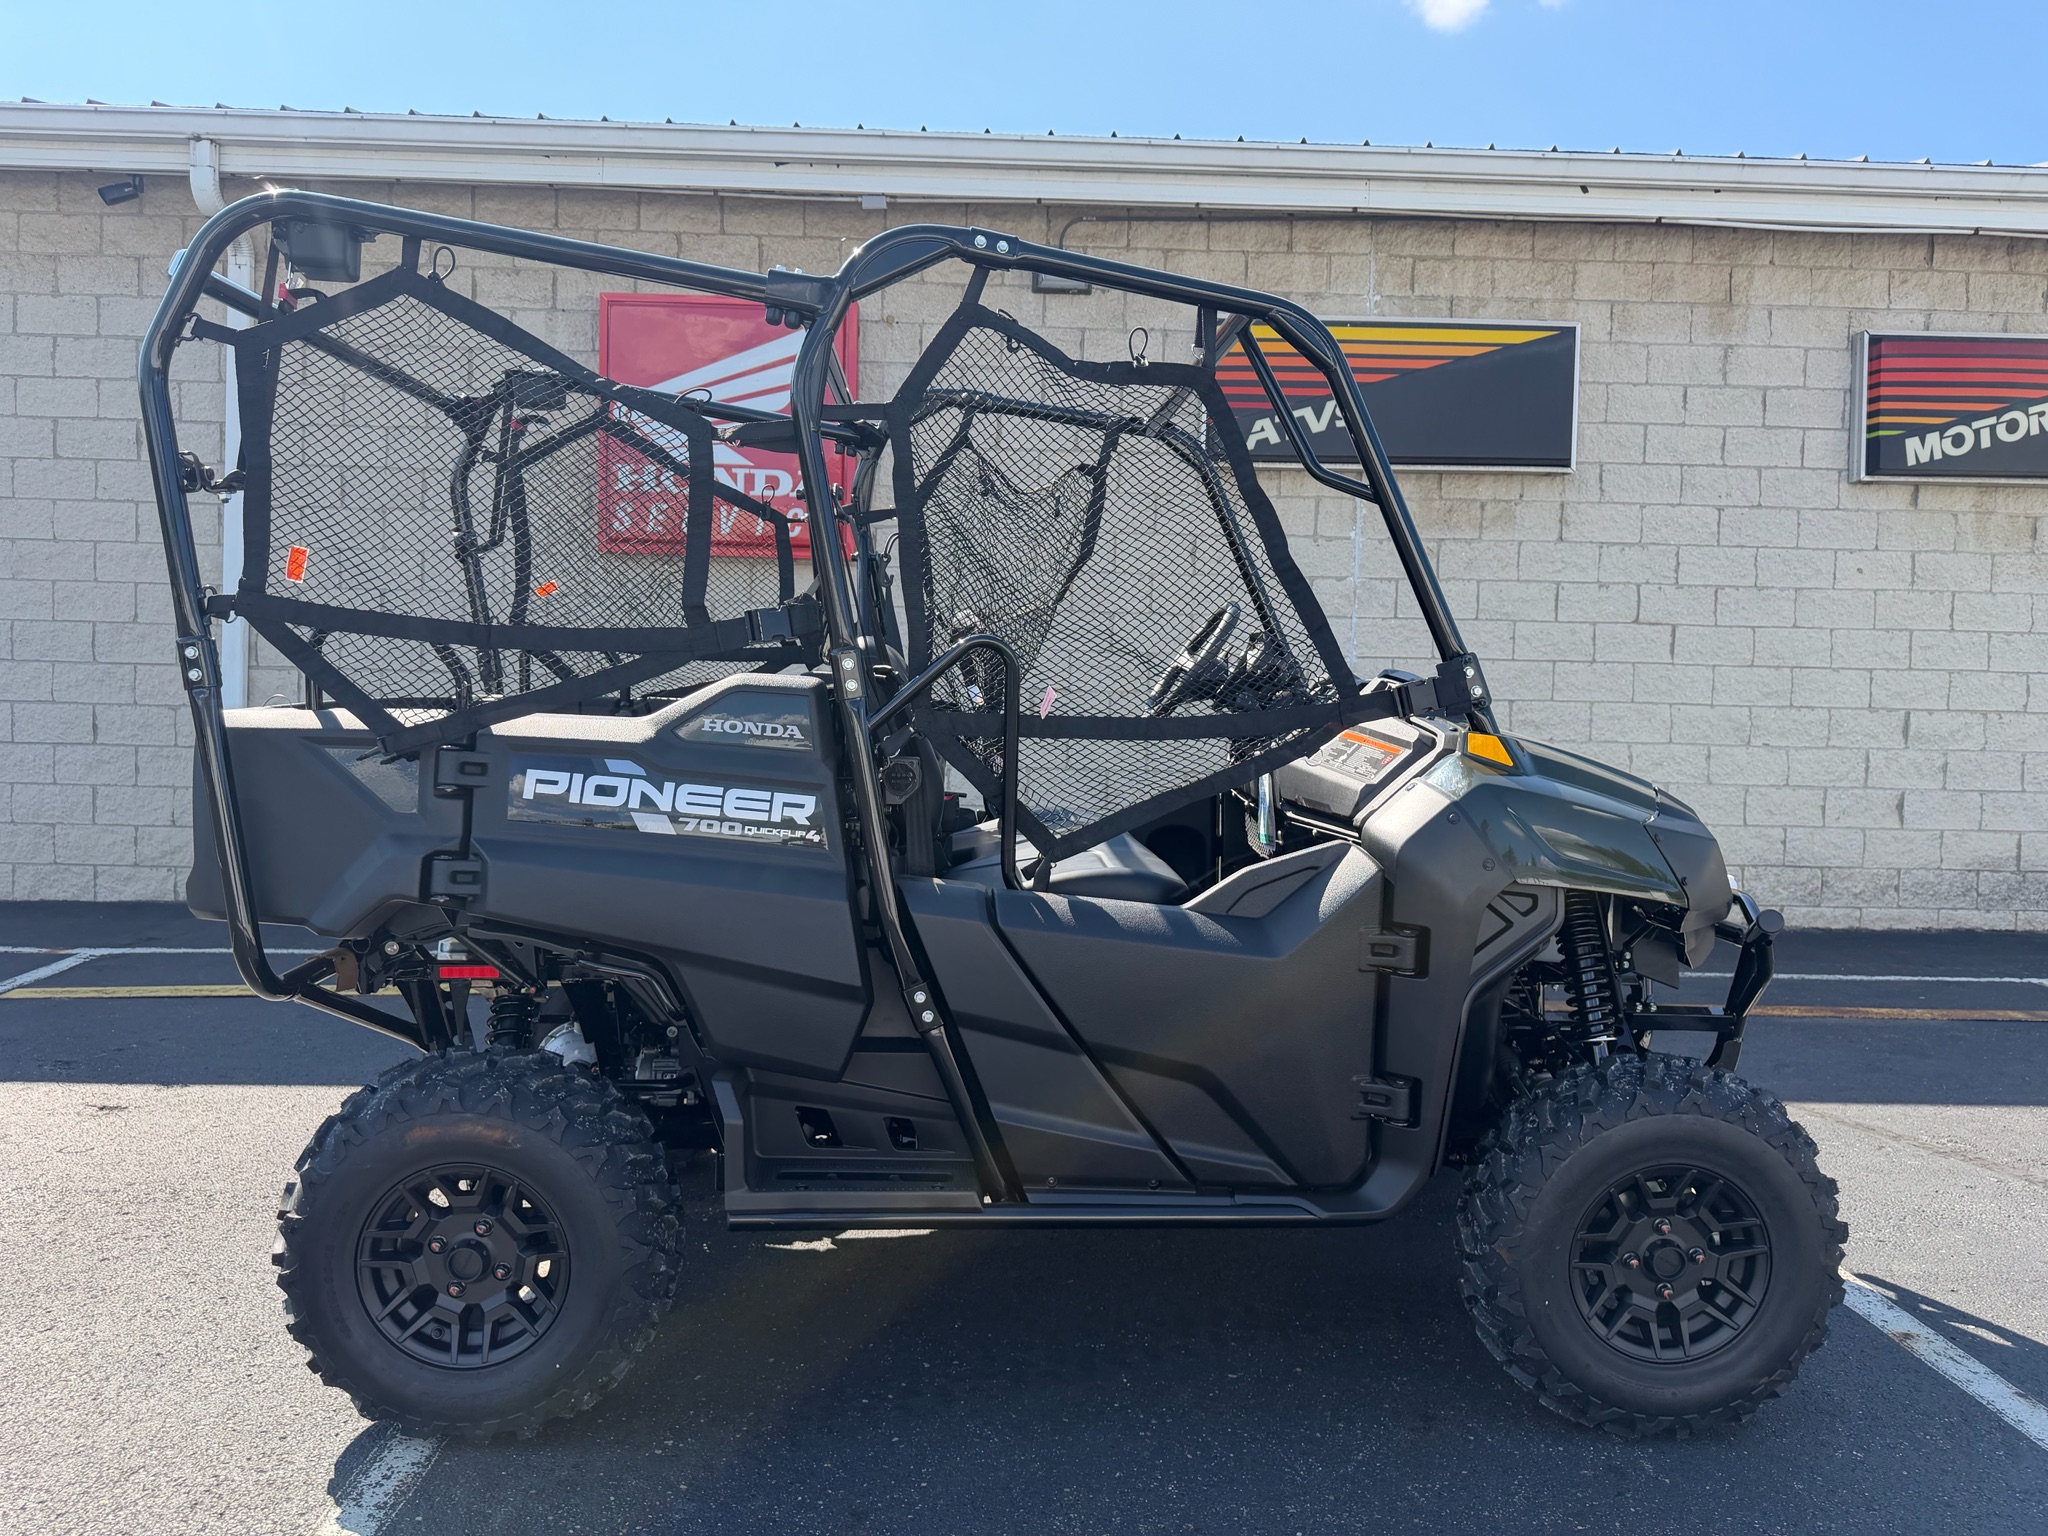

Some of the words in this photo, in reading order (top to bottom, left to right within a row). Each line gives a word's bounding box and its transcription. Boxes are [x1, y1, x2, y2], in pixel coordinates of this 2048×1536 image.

[613, 463, 807, 498] HND
[701, 718, 805, 739] HONDA
[522, 768, 817, 826] PIONEER
[677, 817, 743, 836] 700
